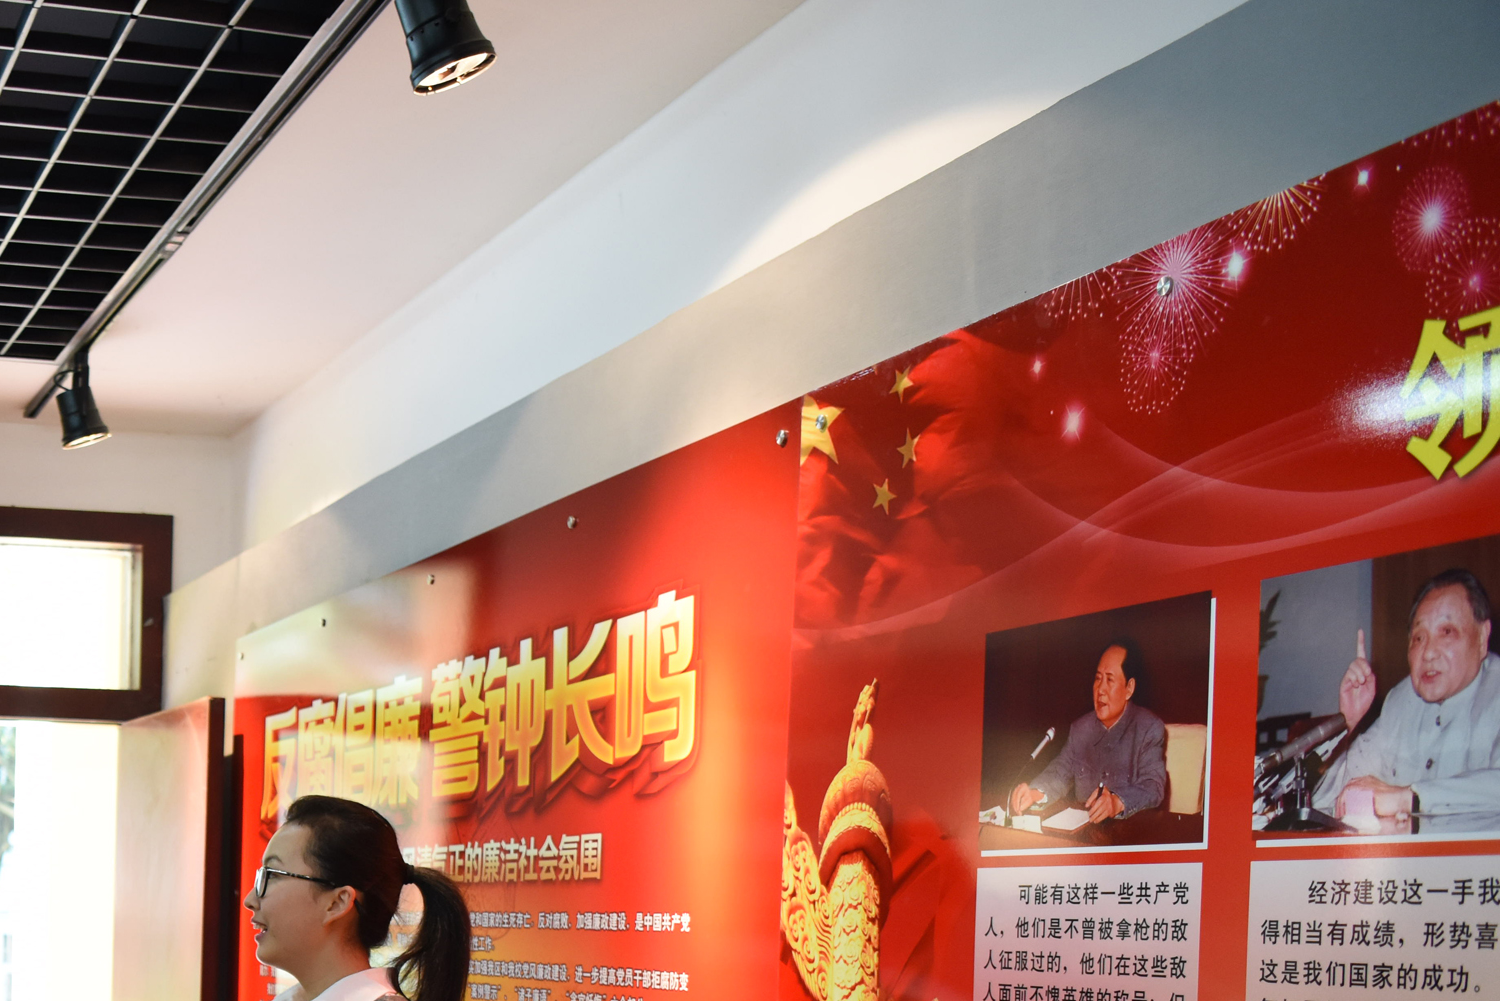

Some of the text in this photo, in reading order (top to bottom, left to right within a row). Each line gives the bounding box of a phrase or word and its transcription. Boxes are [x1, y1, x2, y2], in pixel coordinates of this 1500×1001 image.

[1400, 306, 1500, 481] 领
[260, 589, 696, 820] 反腐倡廉 警钟长鸣
[1018, 881, 1190, 906] 可能有这样一些共产党
[1308, 877, 1500, 906] 经济建设这一手我
[984, 915, 1189, 942] 人，他们是不曾被拿枪的敌
[1260, 919, 1499, 950] 得相当有成绩，形势喜
[983, 949, 1187, 979] 人征服过的，他们在这些敌
[1259, 958, 1481, 994] 这是我们国家的成功。
